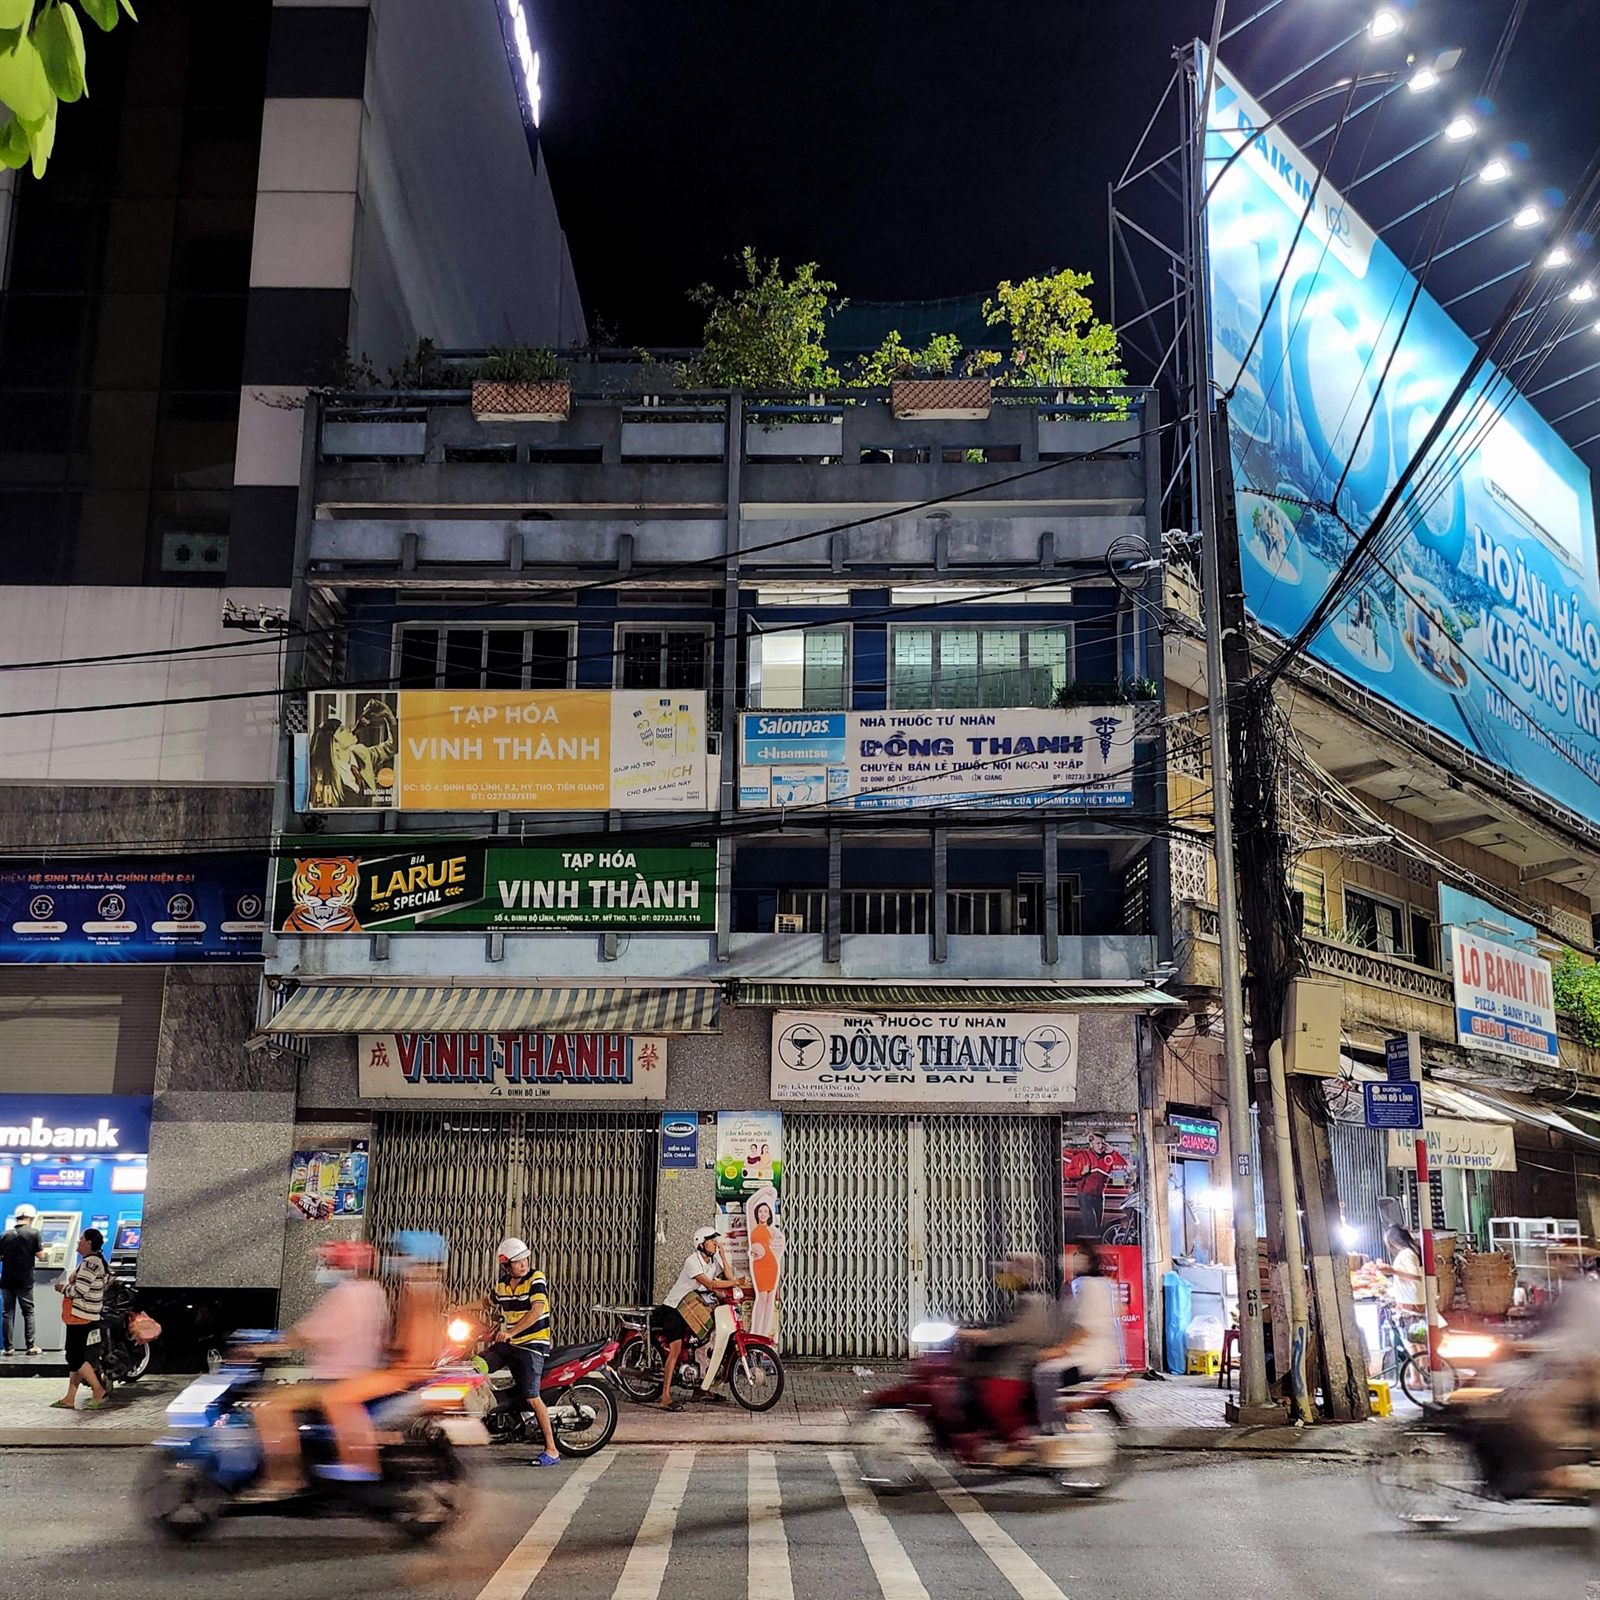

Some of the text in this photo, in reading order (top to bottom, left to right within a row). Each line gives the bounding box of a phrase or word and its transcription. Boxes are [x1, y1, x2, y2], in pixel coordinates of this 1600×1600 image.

[1238, 108, 1317, 213] DAIKIN
[1474, 522, 1600, 672] HOÀN HẢO
[1479, 605, 1570, 717] KHÔNG
[450, 702, 560, 728] TẠP HÓA
[1486, 686, 1521, 730] NÂNG
[758, 718, 829, 737] Salonpas
[860, 713, 996, 728] NHÀ THUỐC TƯ NHÂN
[408, 733, 601, 761] VINH THÀNH
[757, 746, 828, 759] Hisamitsu
[860, 730, 1084, 758] ĐỒNG THANH
[860, 759, 903, 772] CHUYÊN
[908, 759, 931, 772] BÁN
[935, 759, 948, 771] LẺ
[952, 759, 989, 772] THUỐC
[993, 760, 1012, 773] NỘI
[577, 784, 606, 792] GIANG
[1106, 796, 1126, 804] NAM
[411, 855, 425, 865] BIA
[562, 850, 637, 872] TẠP HÓA
[44, 874, 69, 882] SINH
[71, 872, 95, 882] THÁI
[97, 872, 114, 882] TÀI
[116, 872, 148, 882] CHÍNH
[371, 856, 466, 900] LARUE
[393, 889, 442, 911] SPECIAL
[498, 873, 699, 909] VINH THÀNH
[1460, 938, 1481, 988] LÒ
[1484, 948, 1529, 1002] BÁNH
[1474, 995, 1497, 1013] PIZZA
[1524, 1011, 1543, 1027] FLAN
[939, 1015, 961, 1028] TƯ
[965, 1016, 1007, 1028] NHÂN
[1471, 1015, 1506, 1040] CHÂU
[1506, 1024, 1550, 1052] THÀNH
[369, 1041, 390, 1067] 成
[830, 1029, 1024, 1072] ĐỒNG THANH
[818, 1072, 1018, 1084] CHUYÊN BÁN LẺ
[490, 1087, 503, 1096] 4
[1372, 1092, 1413, 1103] ĐINH BỘ LĨNH
[0, 1117, 120, 1147] mbank
[1396, 1128, 1416, 1152] TIỆ
[1238, 1155, 1249, 1164] CS
[1465, 1155, 1492, 1169] PHỤC
[59, 1169, 85, 1180] CDM
[1240, 1165, 1250, 1175] 01
[1246, 1289, 1258, 1300] CS
[1248, 1303, 1258, 1318] 01
